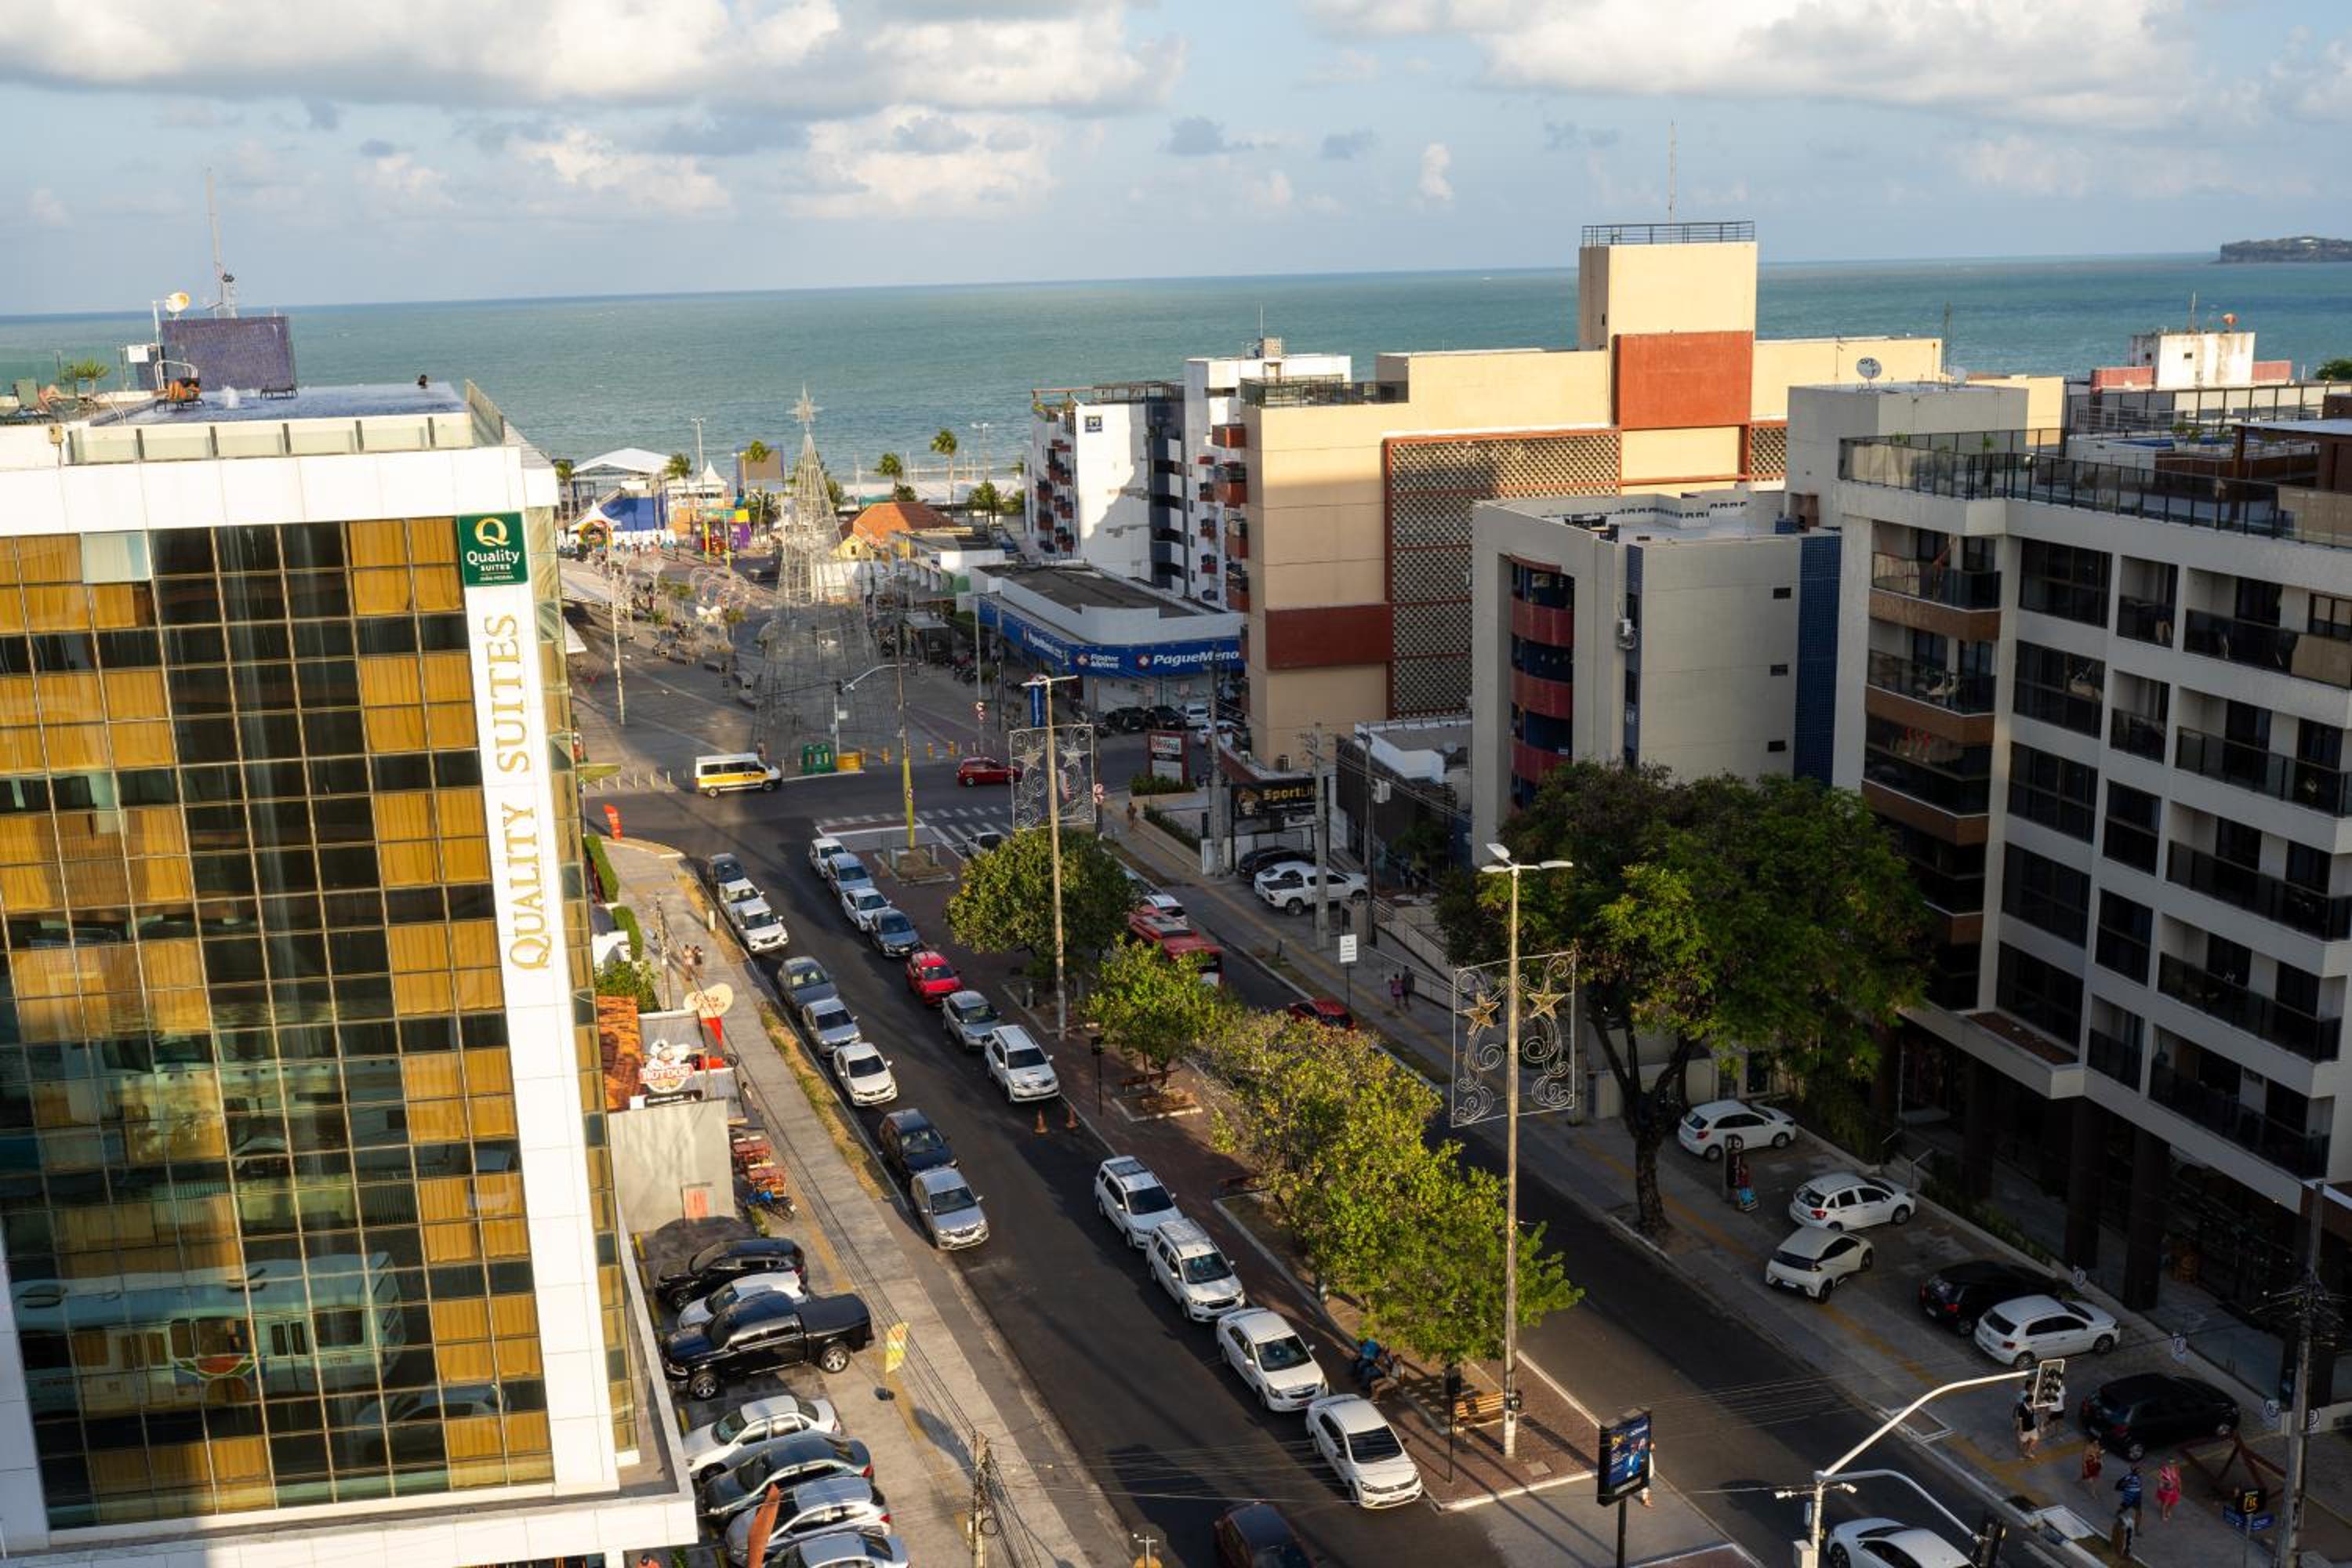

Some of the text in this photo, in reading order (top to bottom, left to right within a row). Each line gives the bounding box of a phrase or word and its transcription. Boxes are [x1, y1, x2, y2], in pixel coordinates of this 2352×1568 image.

[475, 517, 510, 546] Q
[466, 549, 520, 567] Quality
[1153, 651, 1240, 667] PagueMeno
[485, 615, 530, 773] SUITES
[1262, 784, 1316, 802] SportLif
[502, 802, 552, 970] QUALITY
